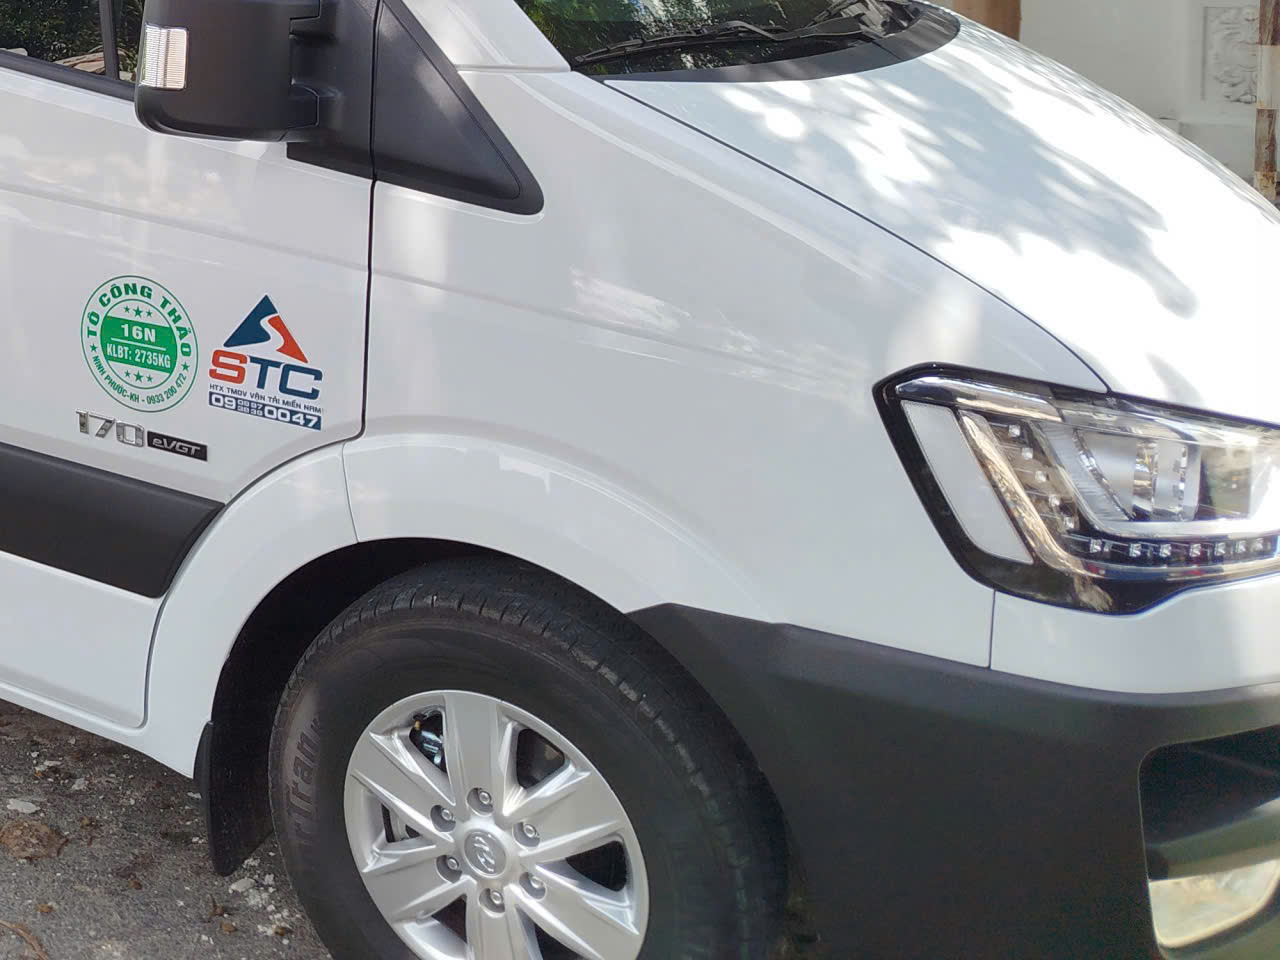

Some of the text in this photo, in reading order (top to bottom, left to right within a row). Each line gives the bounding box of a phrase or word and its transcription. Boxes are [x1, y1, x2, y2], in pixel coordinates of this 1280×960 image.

[98, 282, 153, 308] CÔNG
[121, 323, 156, 343] 16N
[106, 344, 171, 368] KLBT: 2735KG
[146, 393, 165, 405] 0933
[164, 385, 178, 400] 200
[175, 372, 187, 389] 472
[209, 349, 323, 400] STC
[209, 383, 224, 392] HTX
[303, 404, 322, 414] NAM
[211, 394, 318, 427] 09 0047
[76, 408, 145, 448] 170
[152, 438, 200, 456] eVGT
